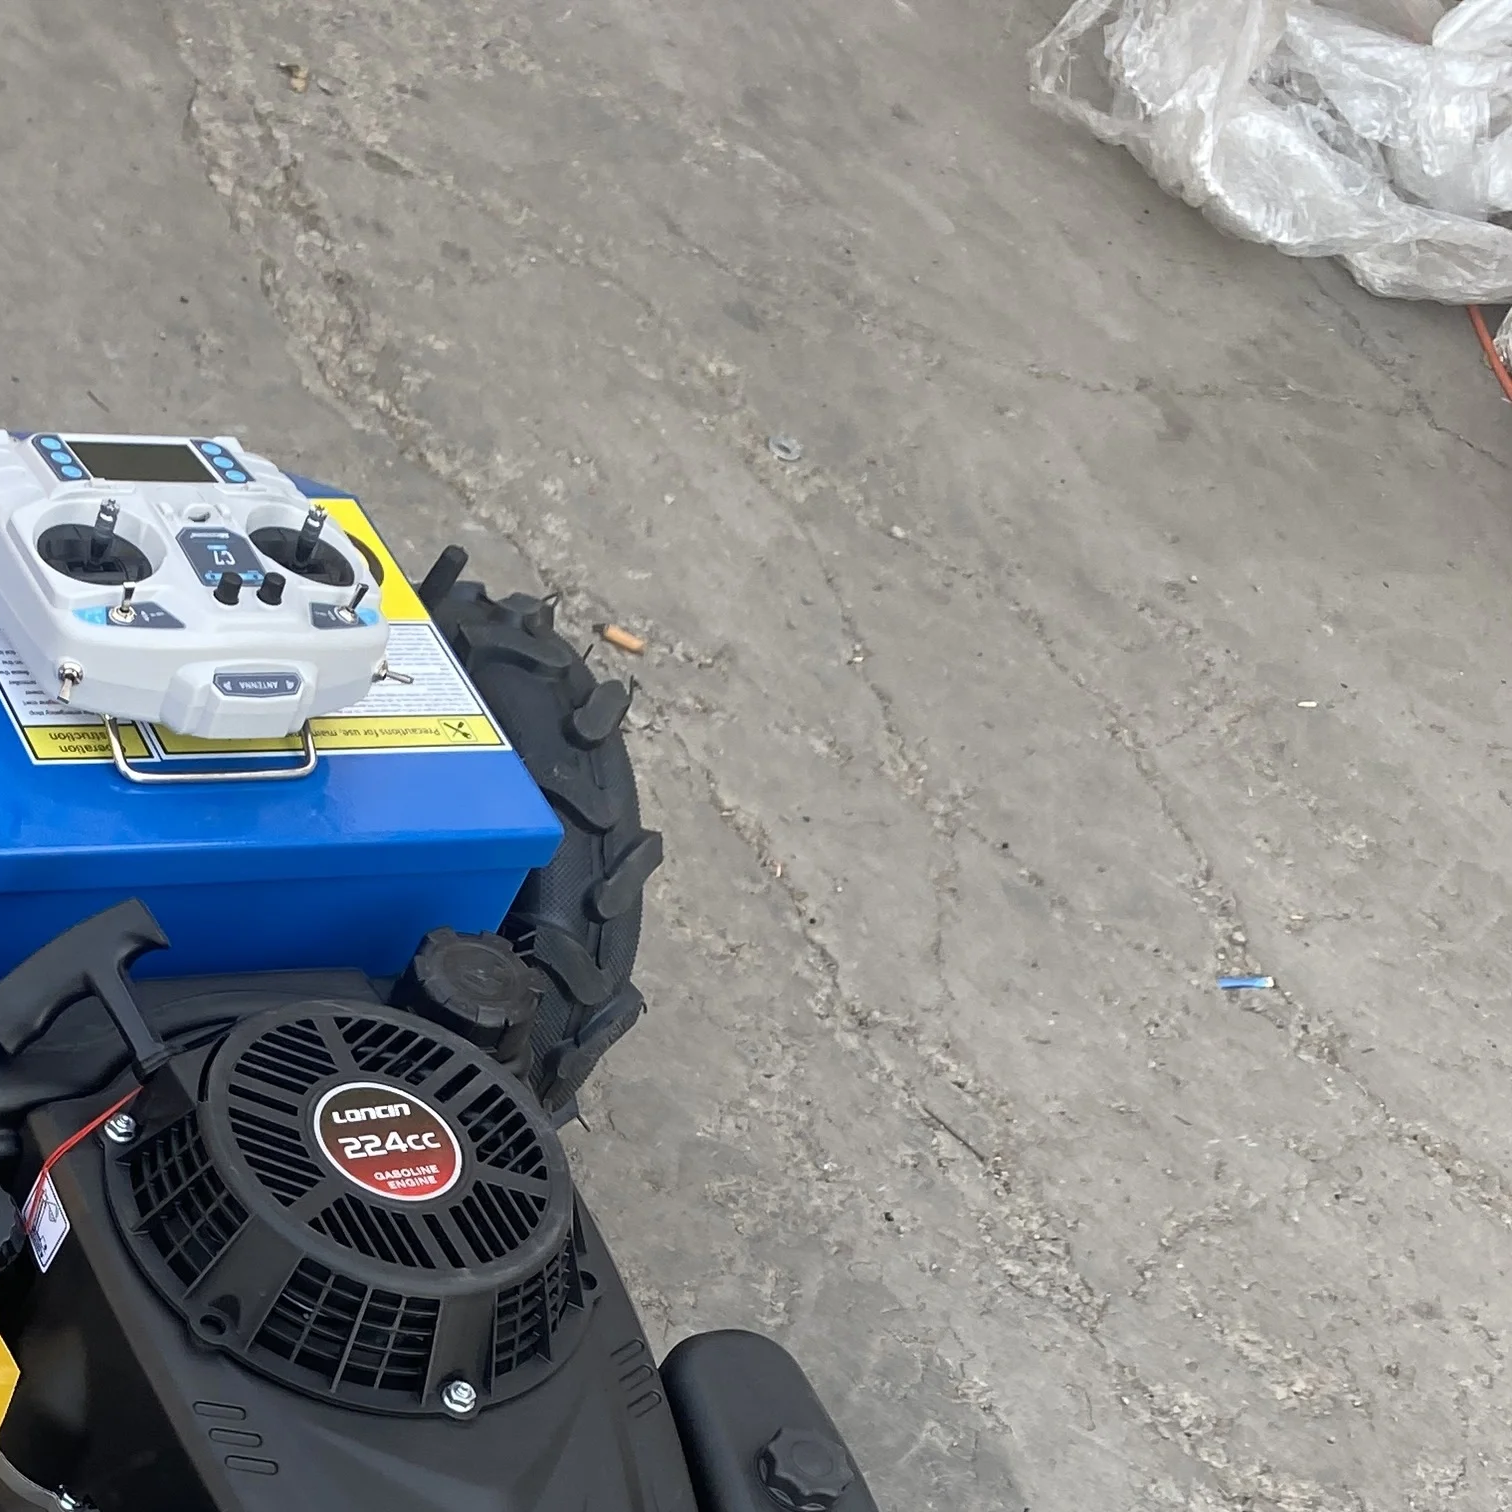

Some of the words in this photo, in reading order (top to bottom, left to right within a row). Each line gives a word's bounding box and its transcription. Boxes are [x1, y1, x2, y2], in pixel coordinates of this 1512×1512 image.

[238, 681, 278, 690] ANTENNA
[49, 731, 110, 742] struction
[363, 728, 379, 737] for
[381, 727, 441, 736] Precautions
[332, 1103, 411, 1124] LONCIN
[373, 1164, 440, 1182] GASOLINE
[387, 1175, 438, 1190] ENGINE
